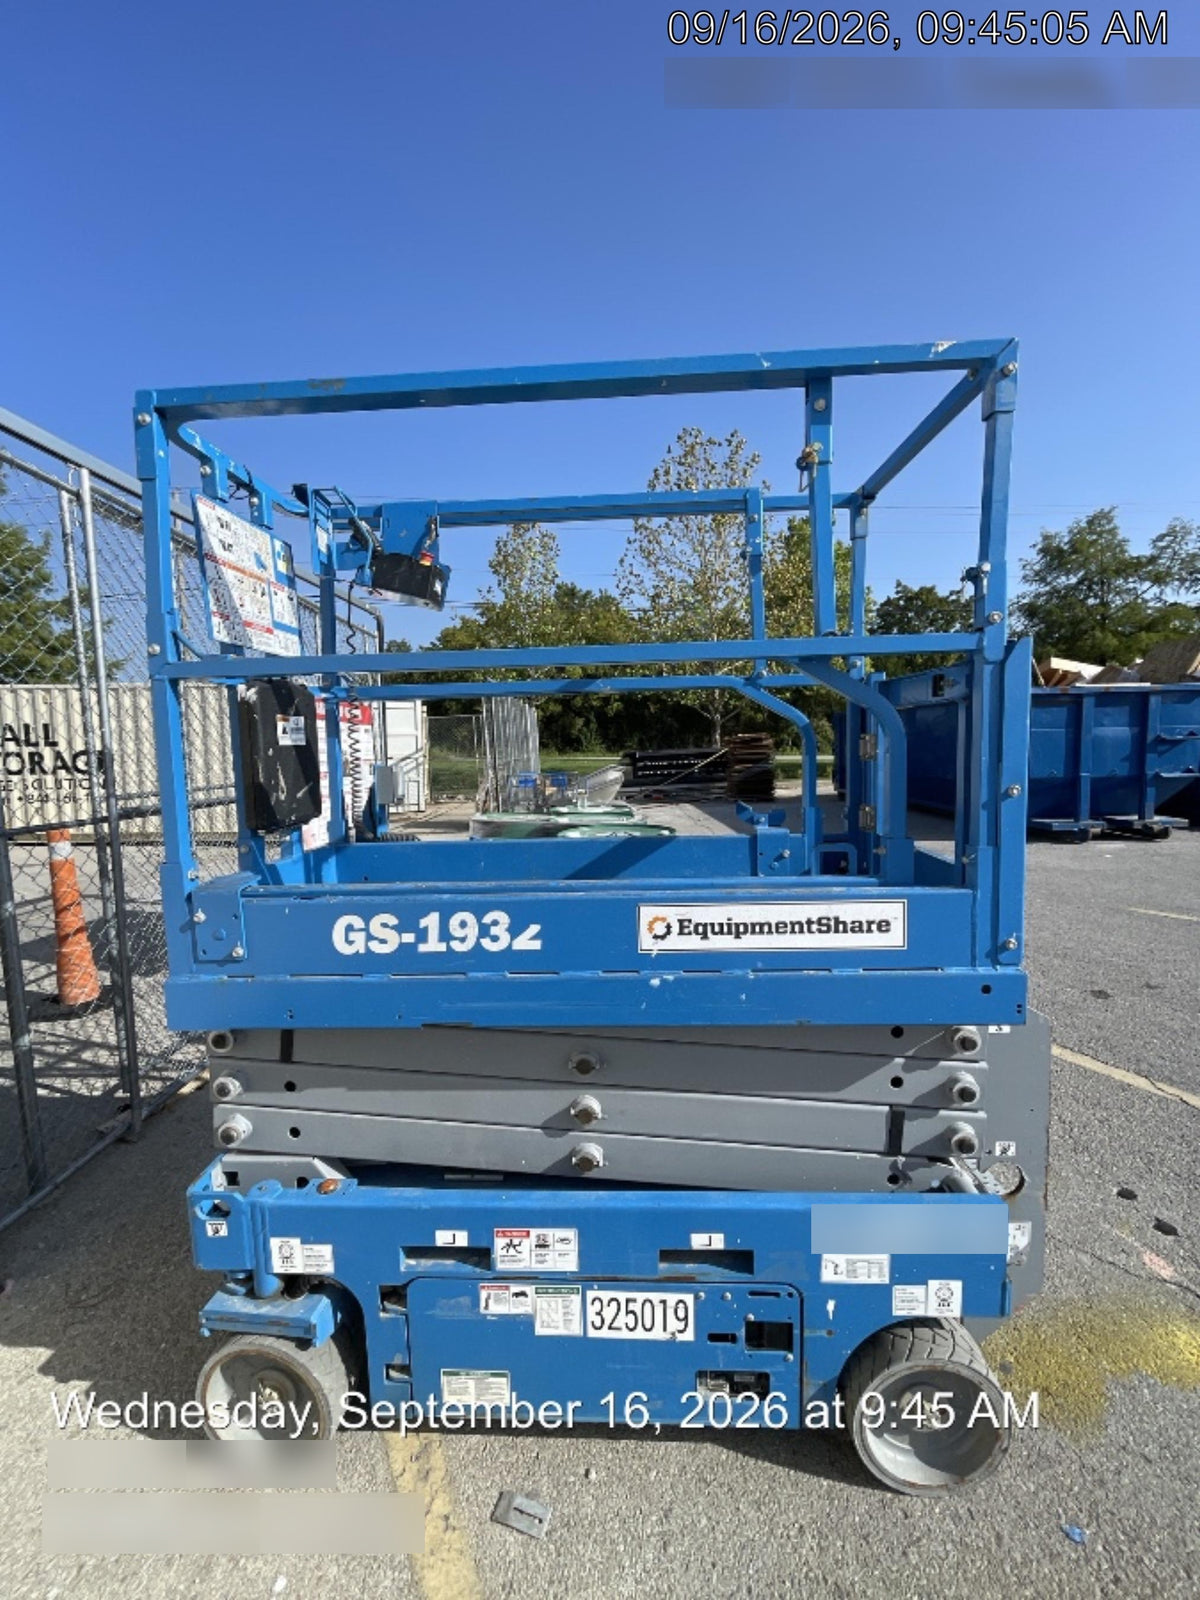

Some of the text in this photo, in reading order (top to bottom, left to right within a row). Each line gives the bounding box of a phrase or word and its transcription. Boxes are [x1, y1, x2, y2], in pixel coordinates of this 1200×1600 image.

[0, 750, 106, 775] ORAG
[332, 910, 542, 955] GS-1932
[677, 916, 892, 940] EquipmentShare
[591, 1297, 689, 1334] 325019
